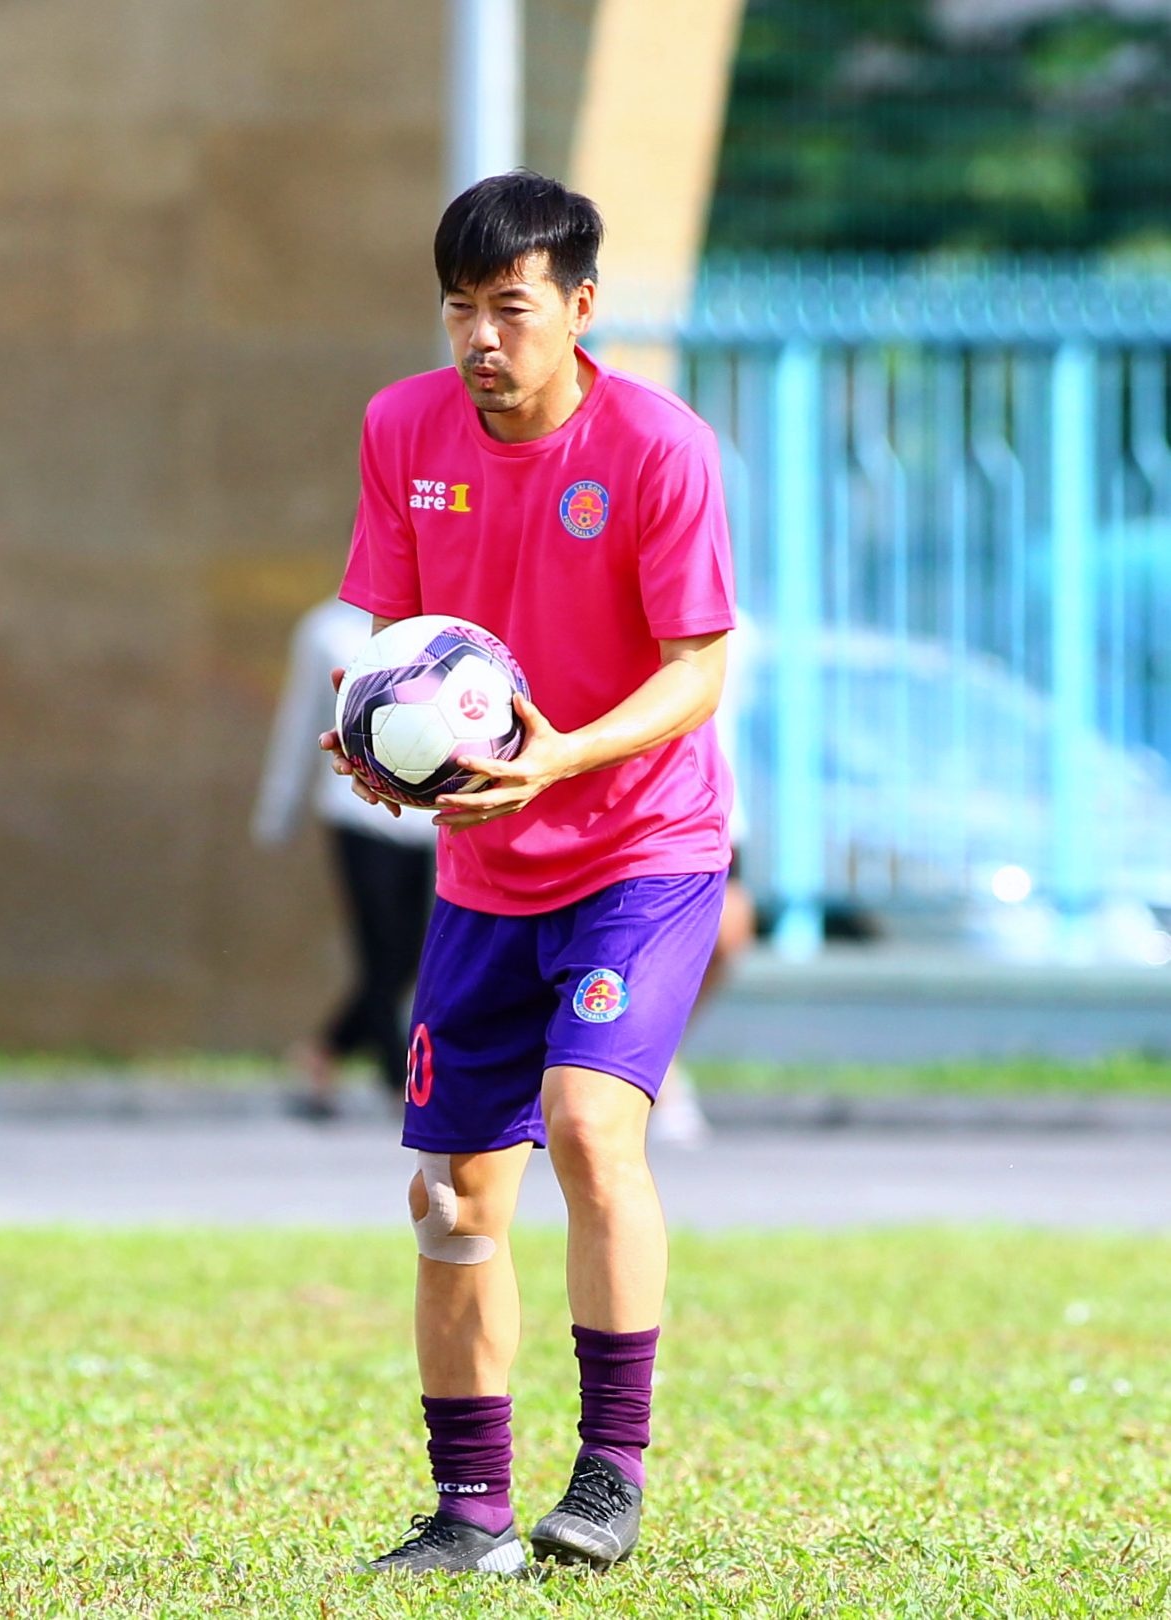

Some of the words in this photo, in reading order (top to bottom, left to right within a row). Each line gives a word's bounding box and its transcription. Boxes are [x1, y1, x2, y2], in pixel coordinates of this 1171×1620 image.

[412, 479, 446, 495] we
[409, 494, 446, 510] are
[448, 484, 472, 512] 1
[436, 1482, 488, 1493] ICRO
